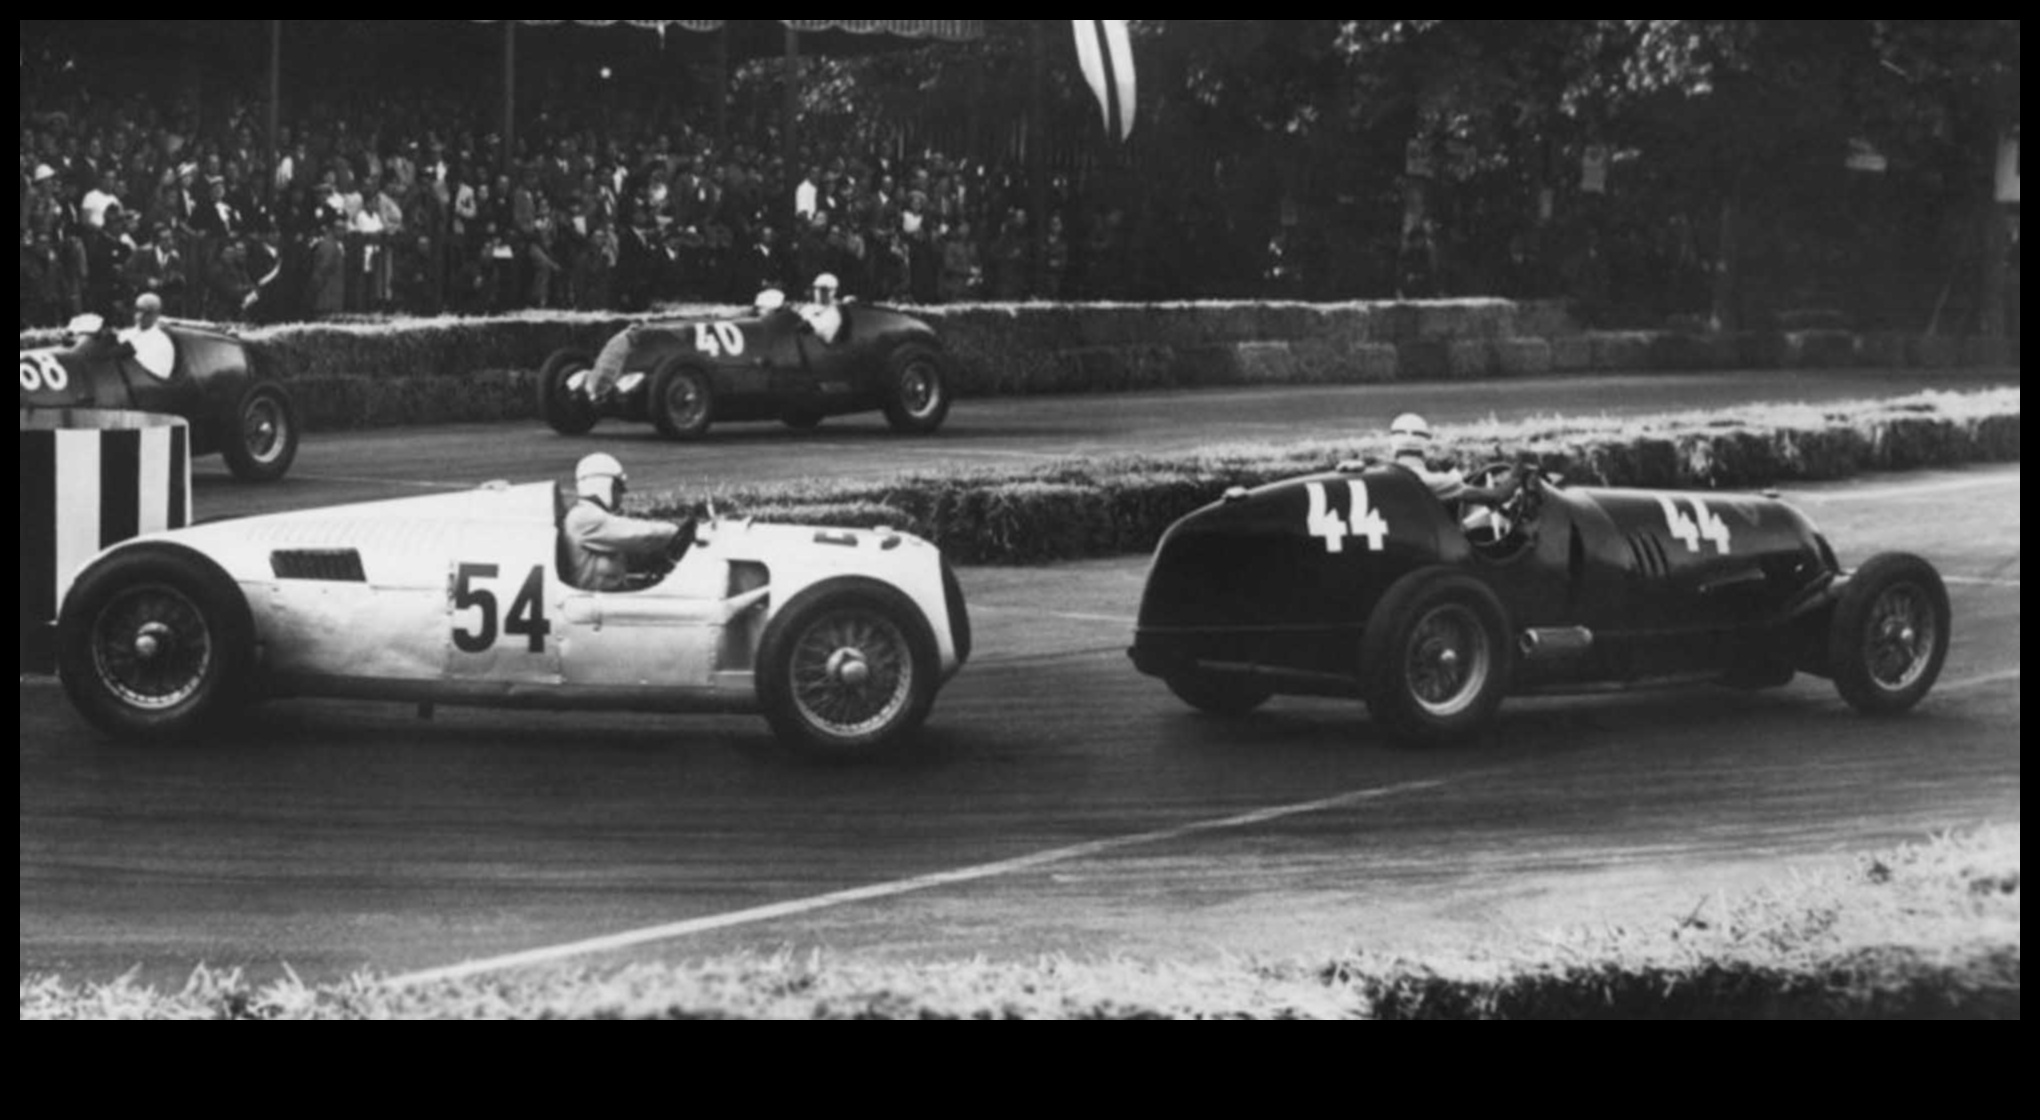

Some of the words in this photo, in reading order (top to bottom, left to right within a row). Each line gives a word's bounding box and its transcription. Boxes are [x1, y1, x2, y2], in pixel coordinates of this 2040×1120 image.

[695, 322, 744, 357] 40
[1305, 479, 1389, 553] 44
[1655, 493, 1731, 555] 44
[452, 562, 551, 654] 54
